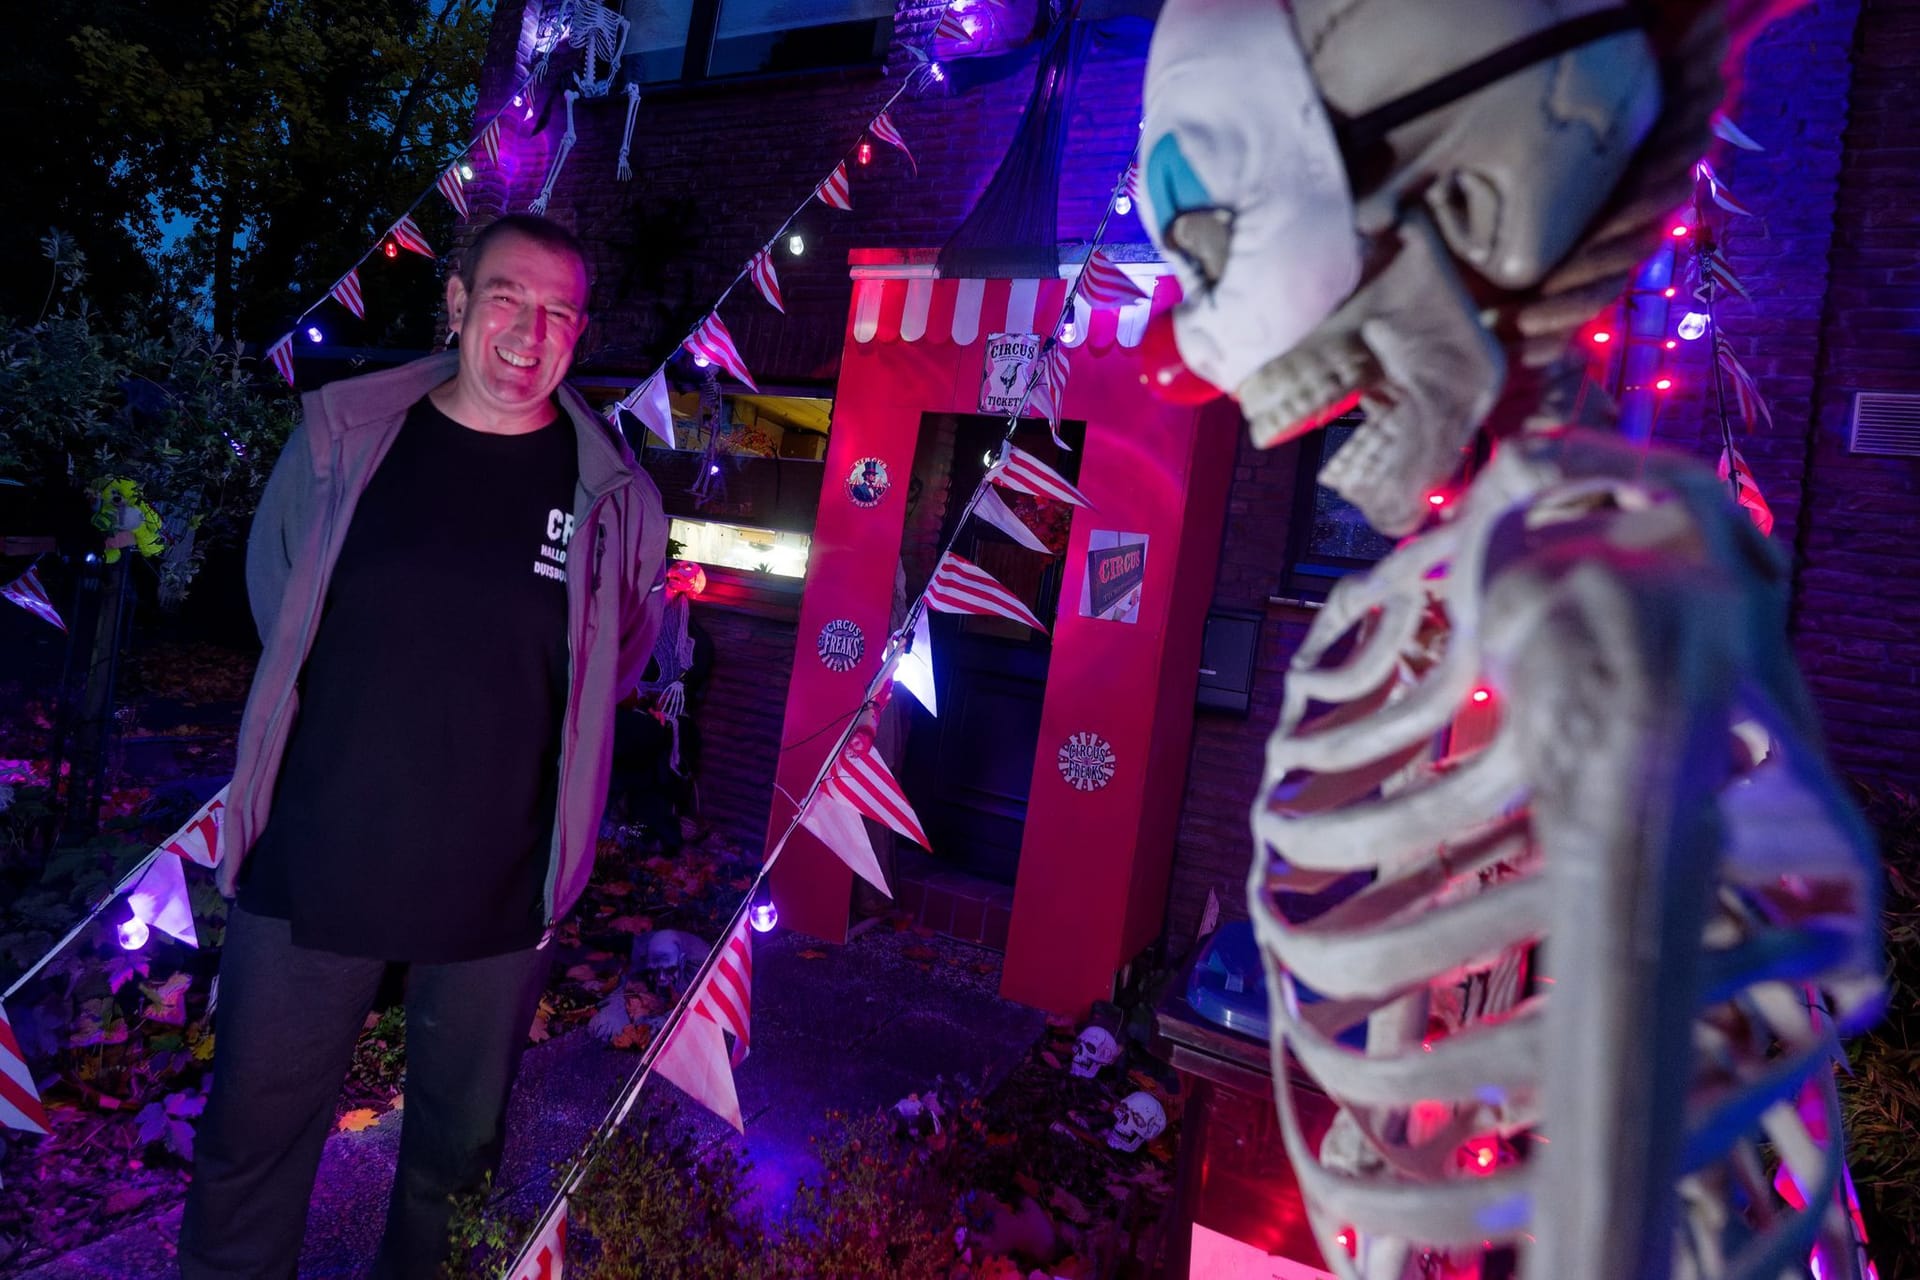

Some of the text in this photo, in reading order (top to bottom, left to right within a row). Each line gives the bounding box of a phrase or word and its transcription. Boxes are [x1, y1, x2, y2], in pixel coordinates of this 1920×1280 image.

[991, 343, 1036, 360] CIRCUS
[541, 544, 567, 564] HALLO
[533, 560, 567, 583] DUISBU
[1099, 550, 1140, 584] CIRCUS
[826, 619, 862, 637] CIRCUS
[824, 632, 860, 660] FREAKS
[1069, 744, 1106, 763] CIRCUS
[1068, 760, 1105, 781] FREAKS
